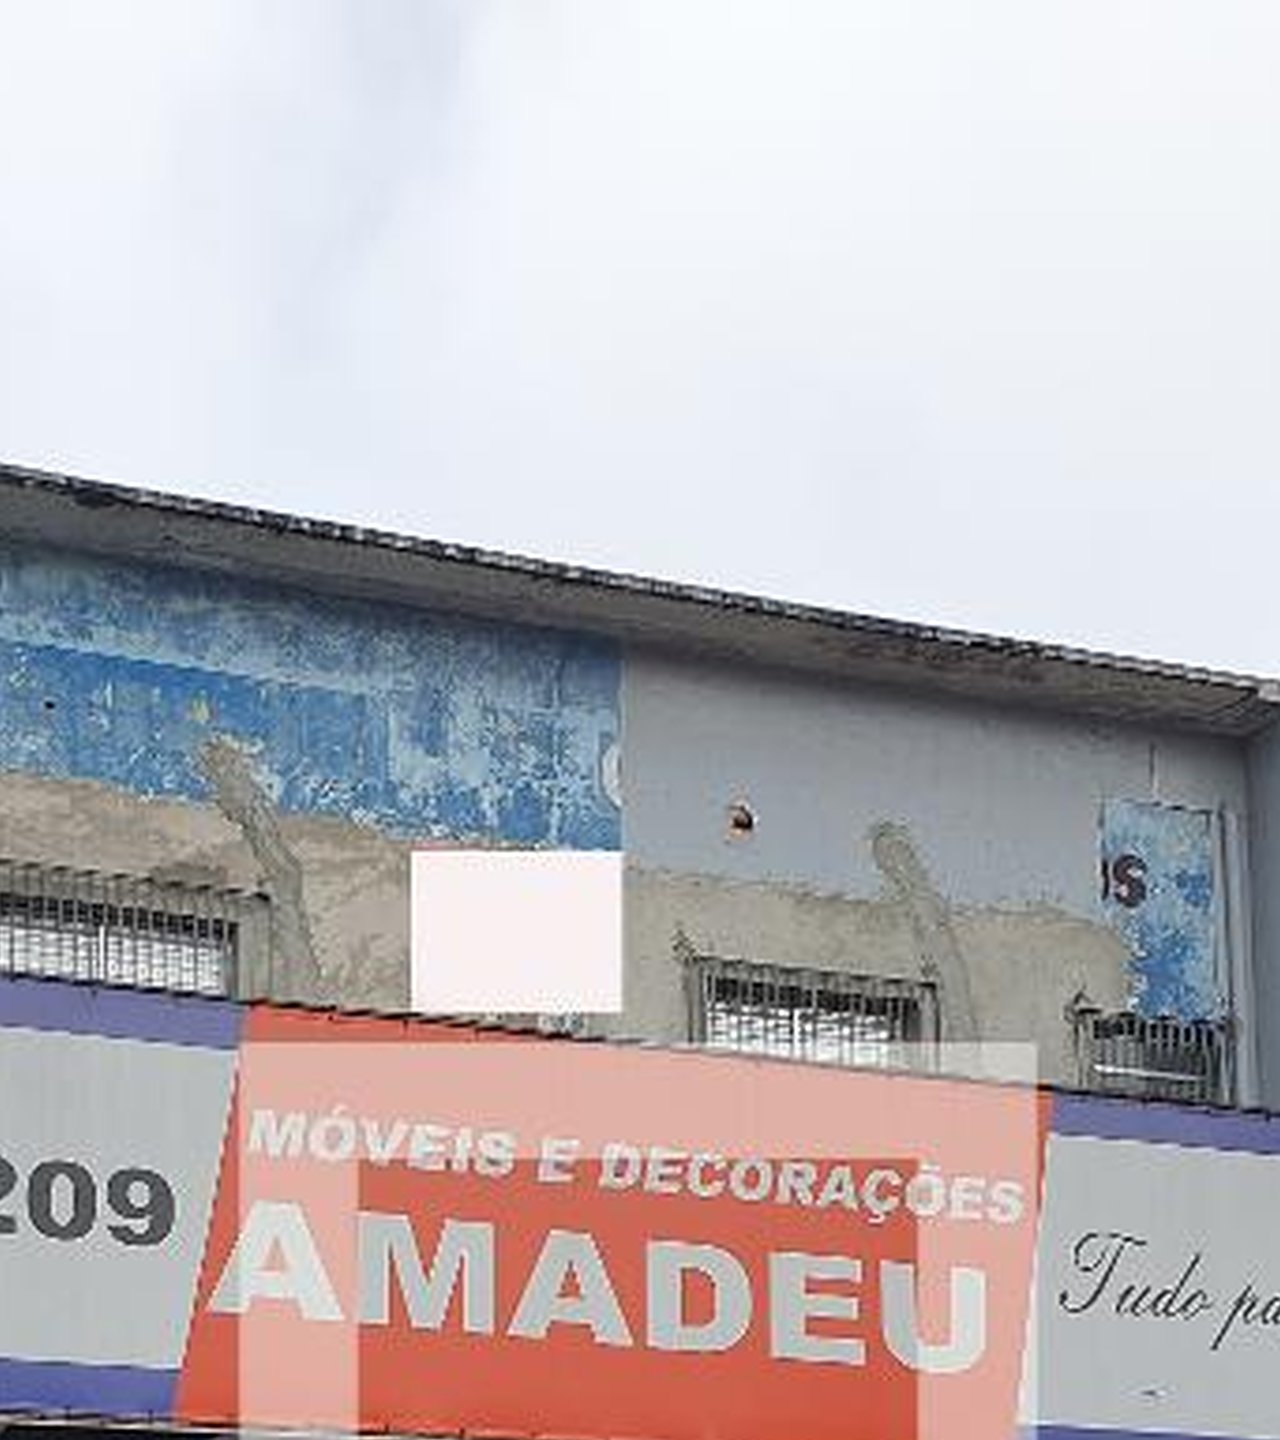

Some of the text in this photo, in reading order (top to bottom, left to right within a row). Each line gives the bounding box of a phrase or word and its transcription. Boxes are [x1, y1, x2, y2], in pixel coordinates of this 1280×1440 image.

[248, 1106, 1024, 1224] MÓVEIS E DECORAÇÕES
[206, 1200, 988, 1374] AMADEU
[1059, 1230, 1214, 1316] Tudo
